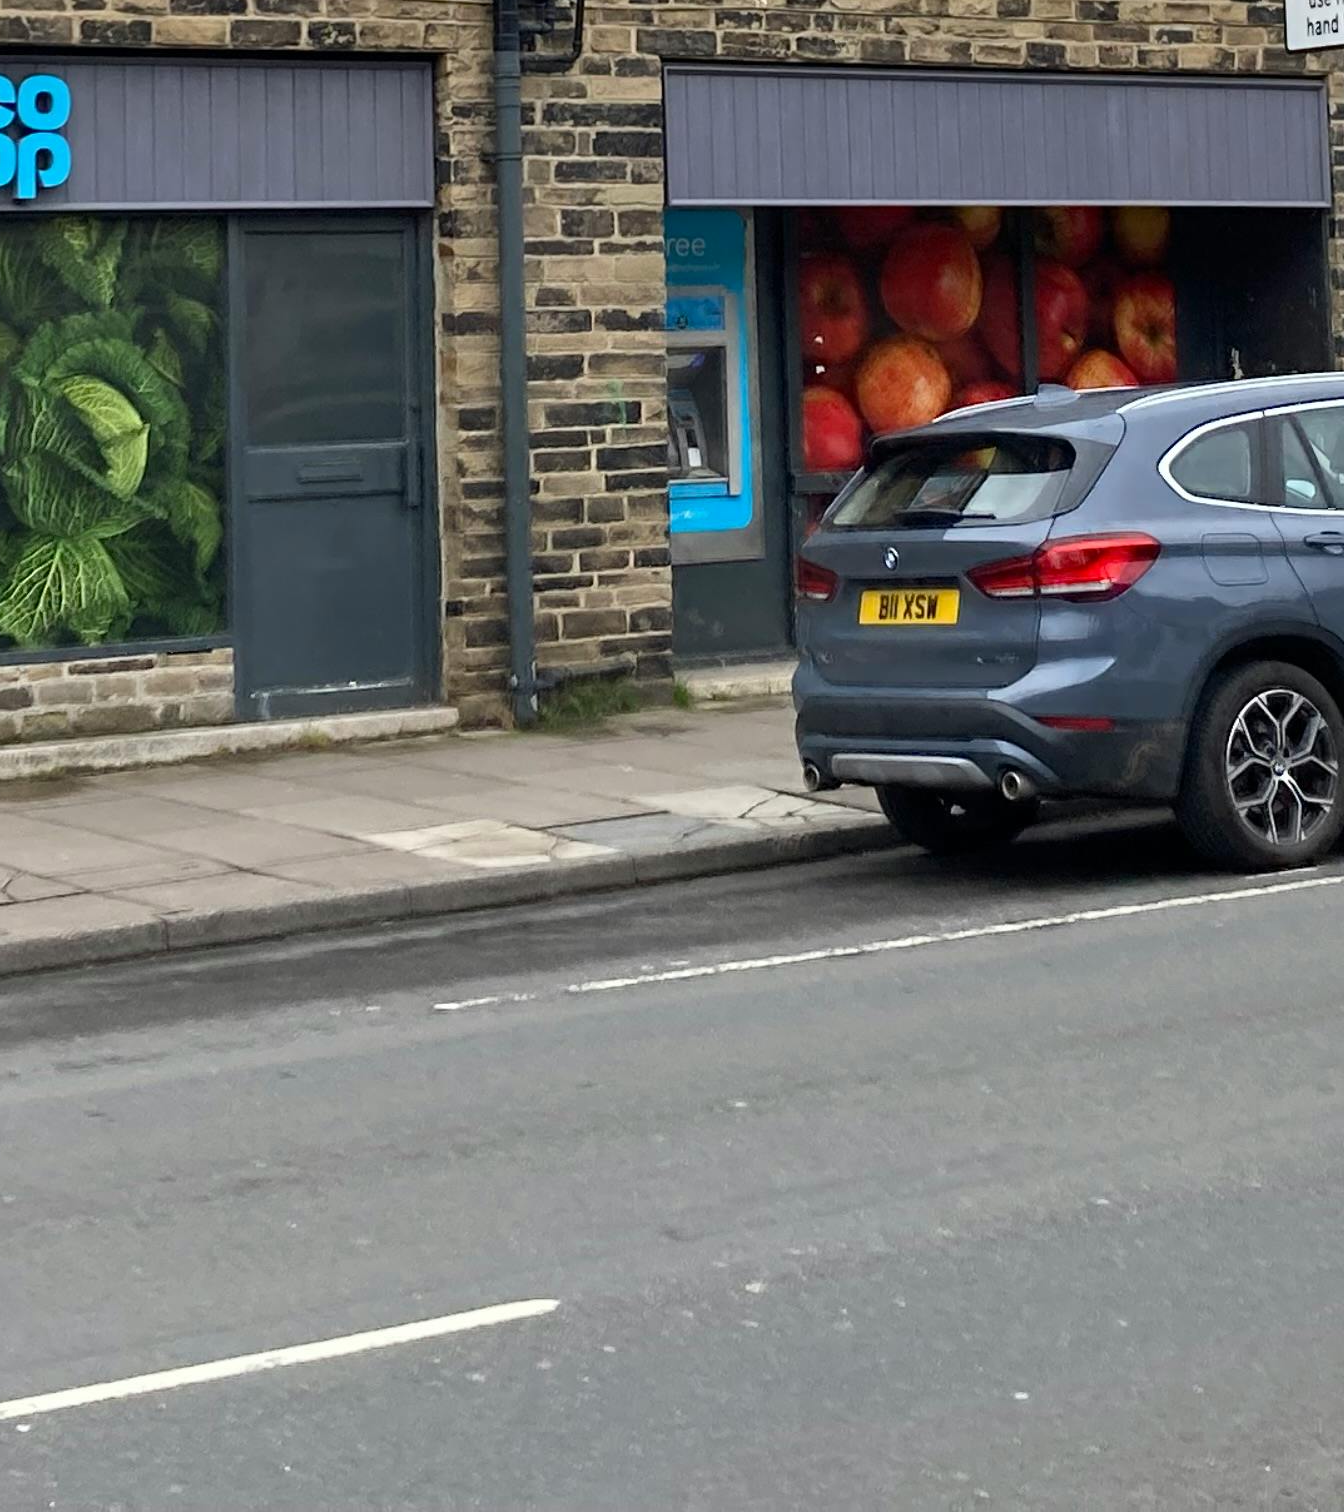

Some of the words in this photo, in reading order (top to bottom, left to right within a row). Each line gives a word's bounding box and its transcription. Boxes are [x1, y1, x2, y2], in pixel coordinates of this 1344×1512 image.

[1306, 13, 1338, 37] hand
[666, 237, 706, 257] ree
[903, 593, 939, 620] XSW
